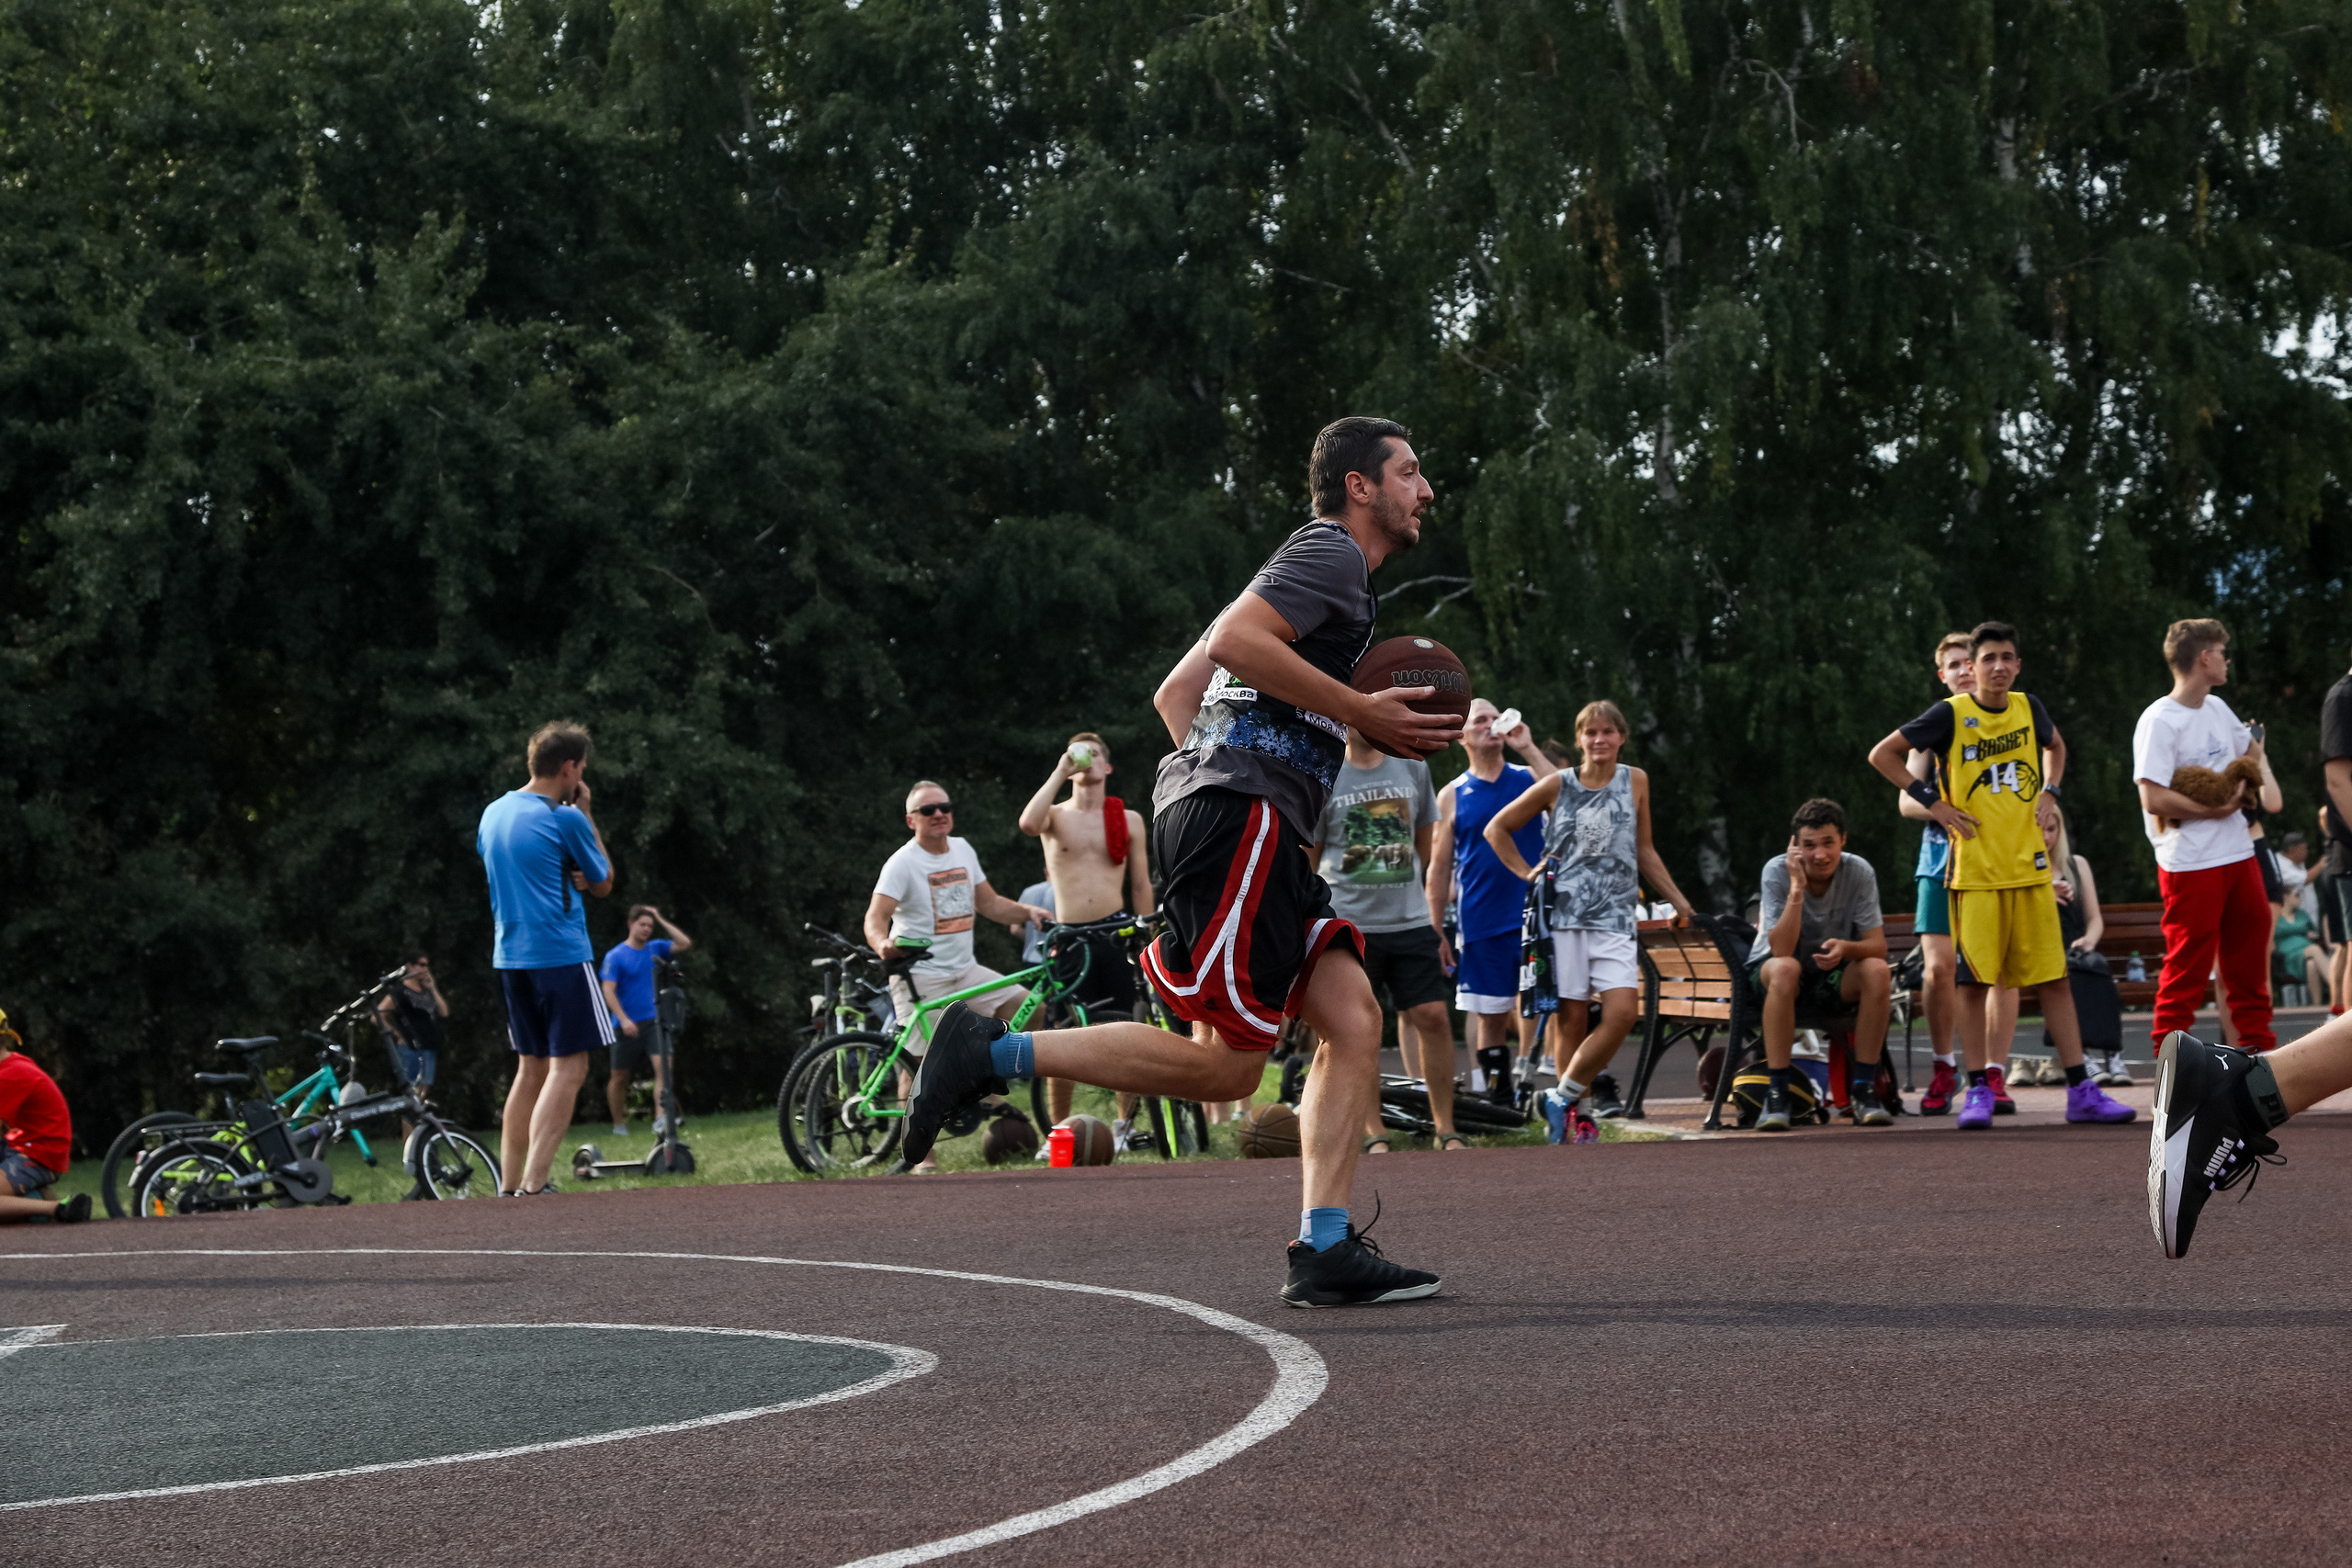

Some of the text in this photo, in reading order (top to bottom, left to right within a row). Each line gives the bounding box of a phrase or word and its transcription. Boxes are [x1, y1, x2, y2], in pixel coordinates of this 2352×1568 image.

[1391, 669, 1467, 696] Wilson
[1989, 761, 2019, 795] 14
[1332, 786, 1415, 808] THAILAND
[2203, 1136, 2235, 1178] PUMA
